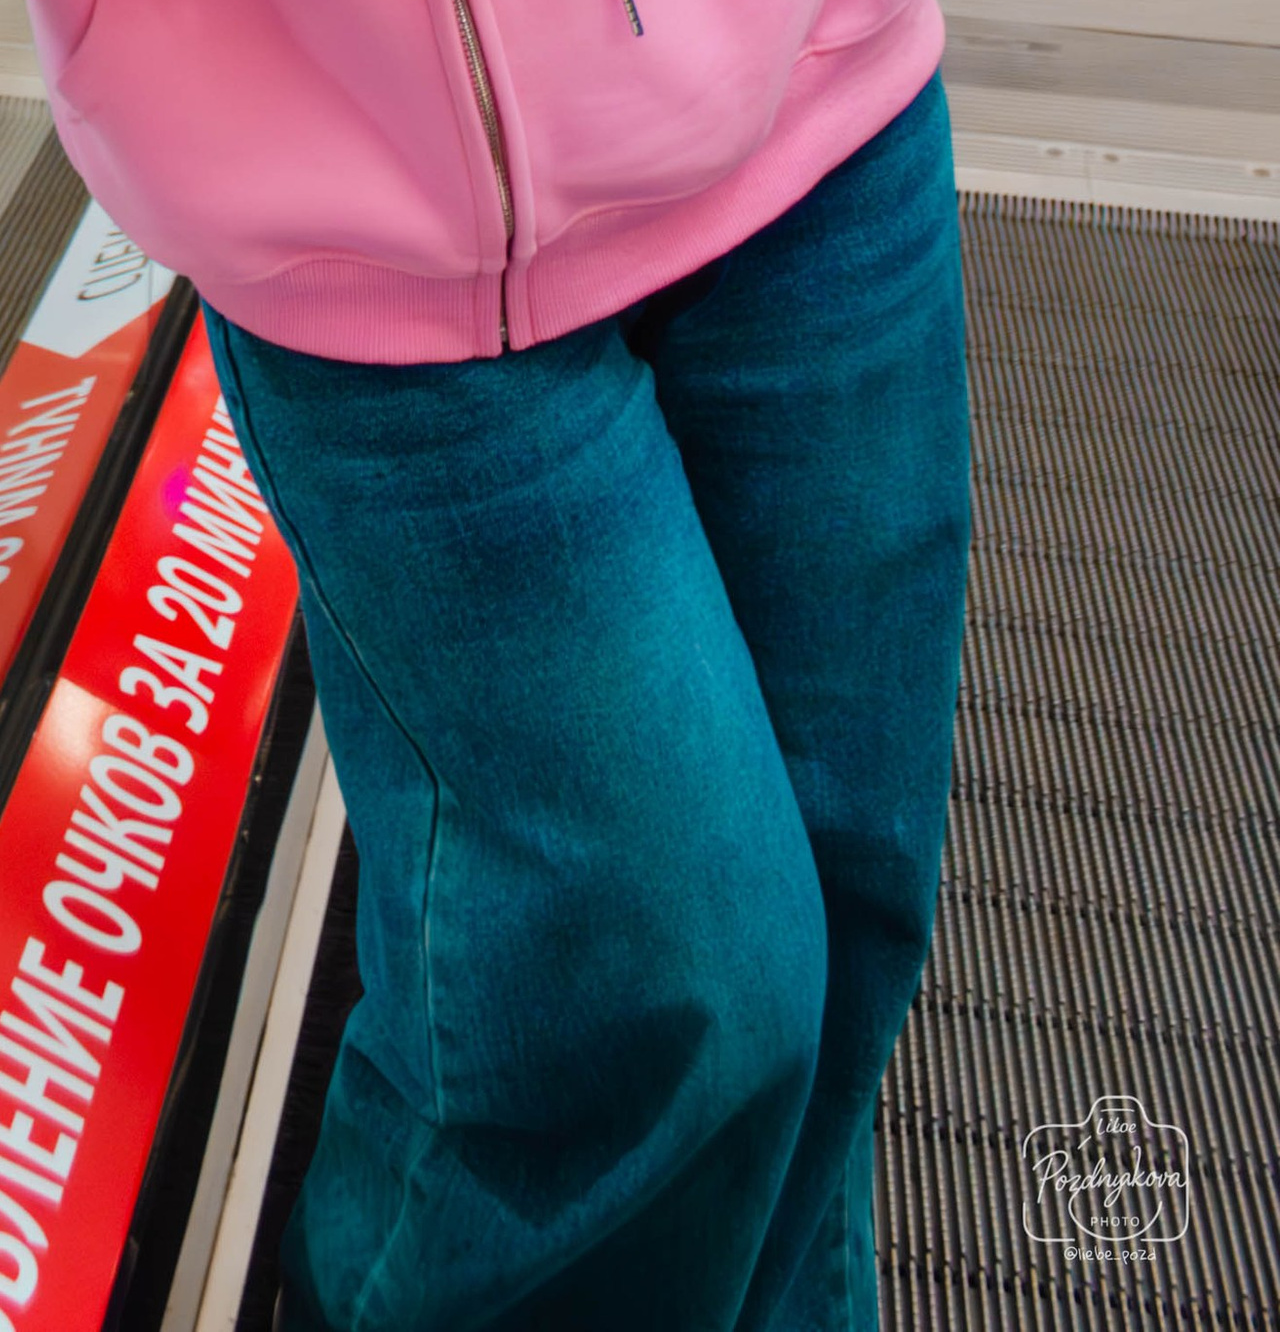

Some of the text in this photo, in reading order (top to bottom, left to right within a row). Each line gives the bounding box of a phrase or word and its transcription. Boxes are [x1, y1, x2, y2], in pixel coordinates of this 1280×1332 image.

[147, 555, 244, 651] 20
[120, 633, 224, 736] ЗА
[42, 714, 196, 957] ОЧКОВ
